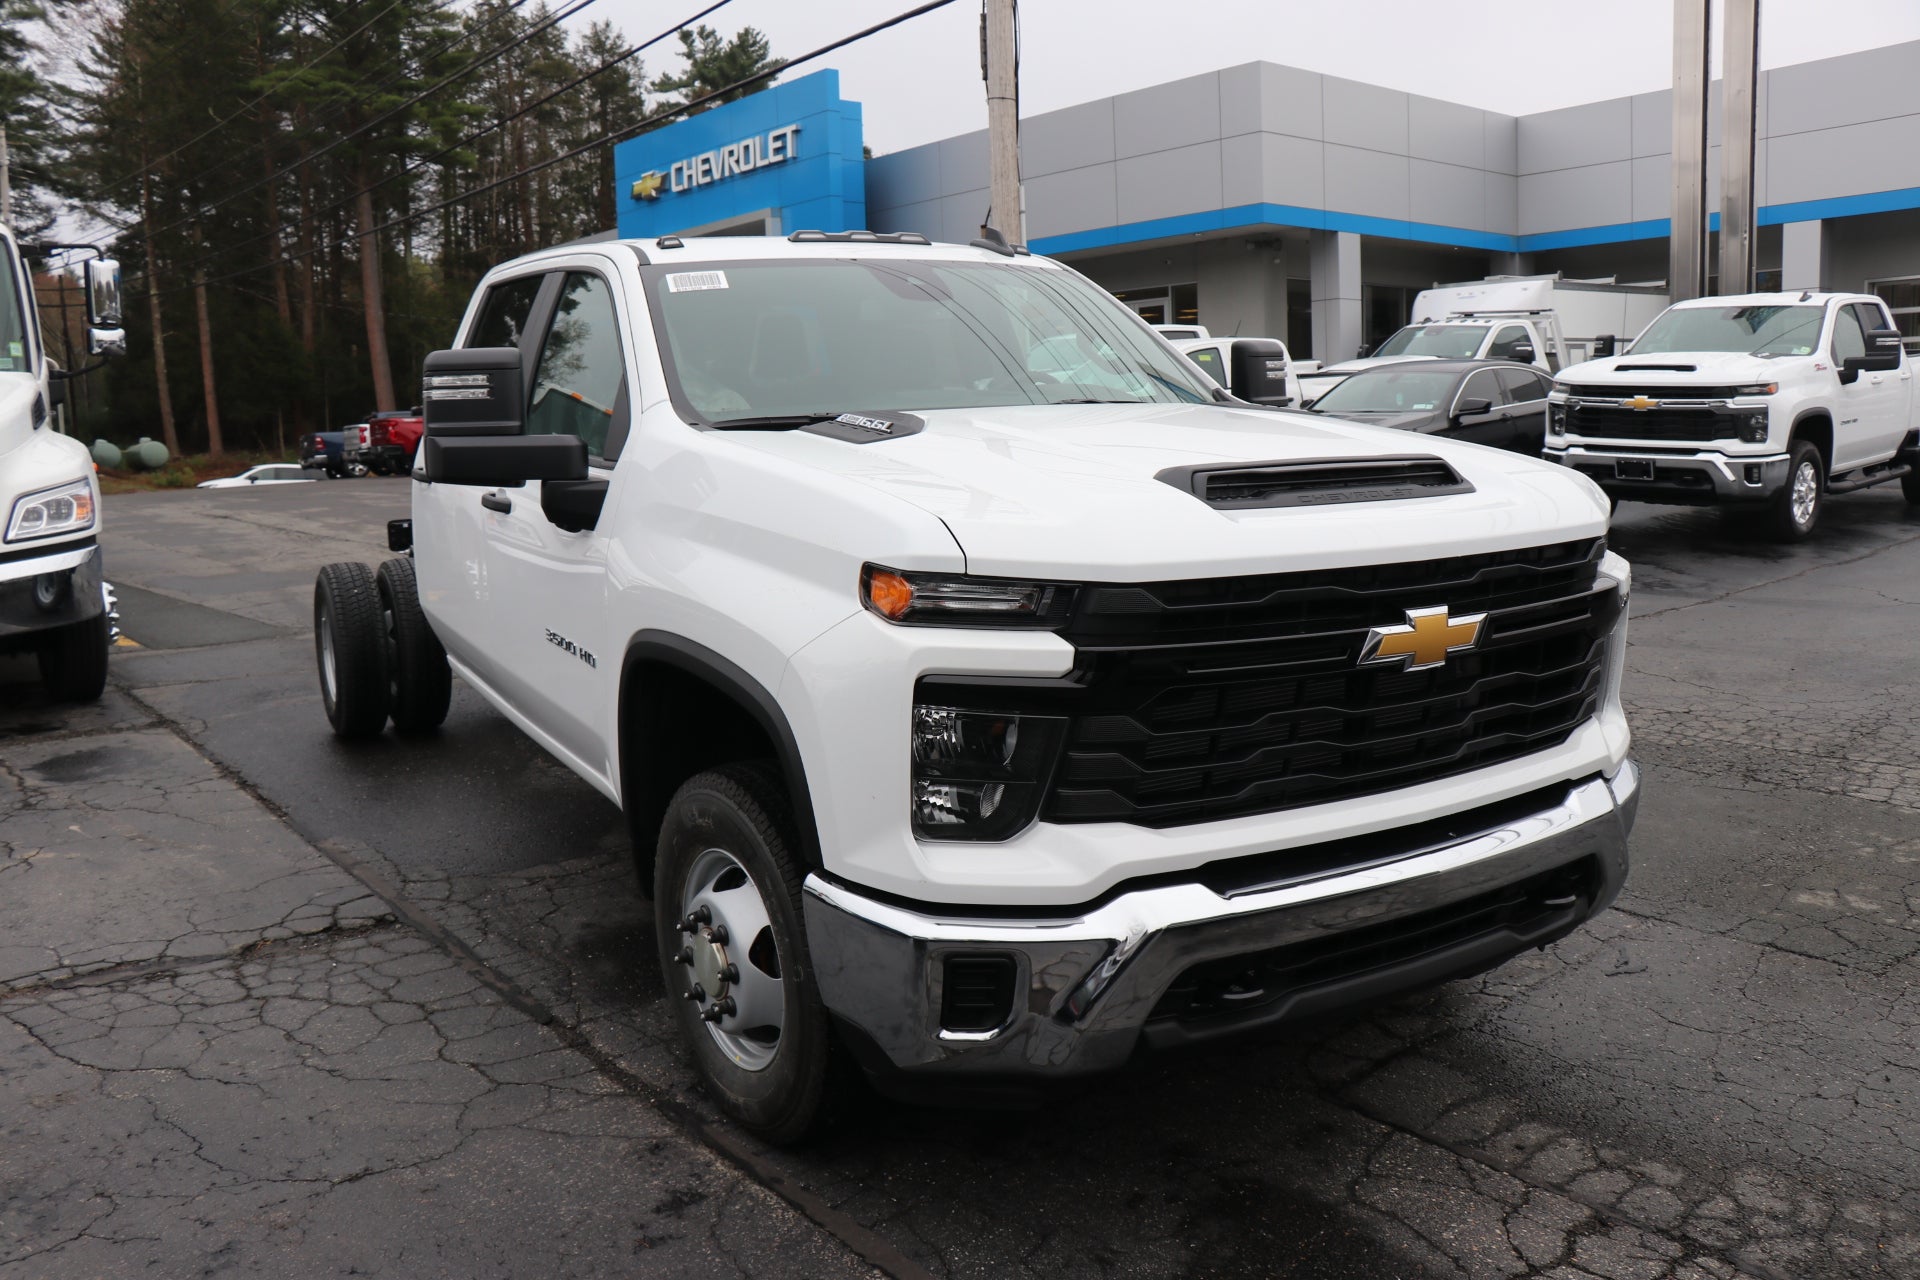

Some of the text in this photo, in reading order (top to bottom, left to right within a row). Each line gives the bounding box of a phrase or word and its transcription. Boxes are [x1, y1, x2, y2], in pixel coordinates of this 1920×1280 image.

[670, 124, 801, 193] CHEVROLET
[545, 628, 597, 669] 3500 HD
